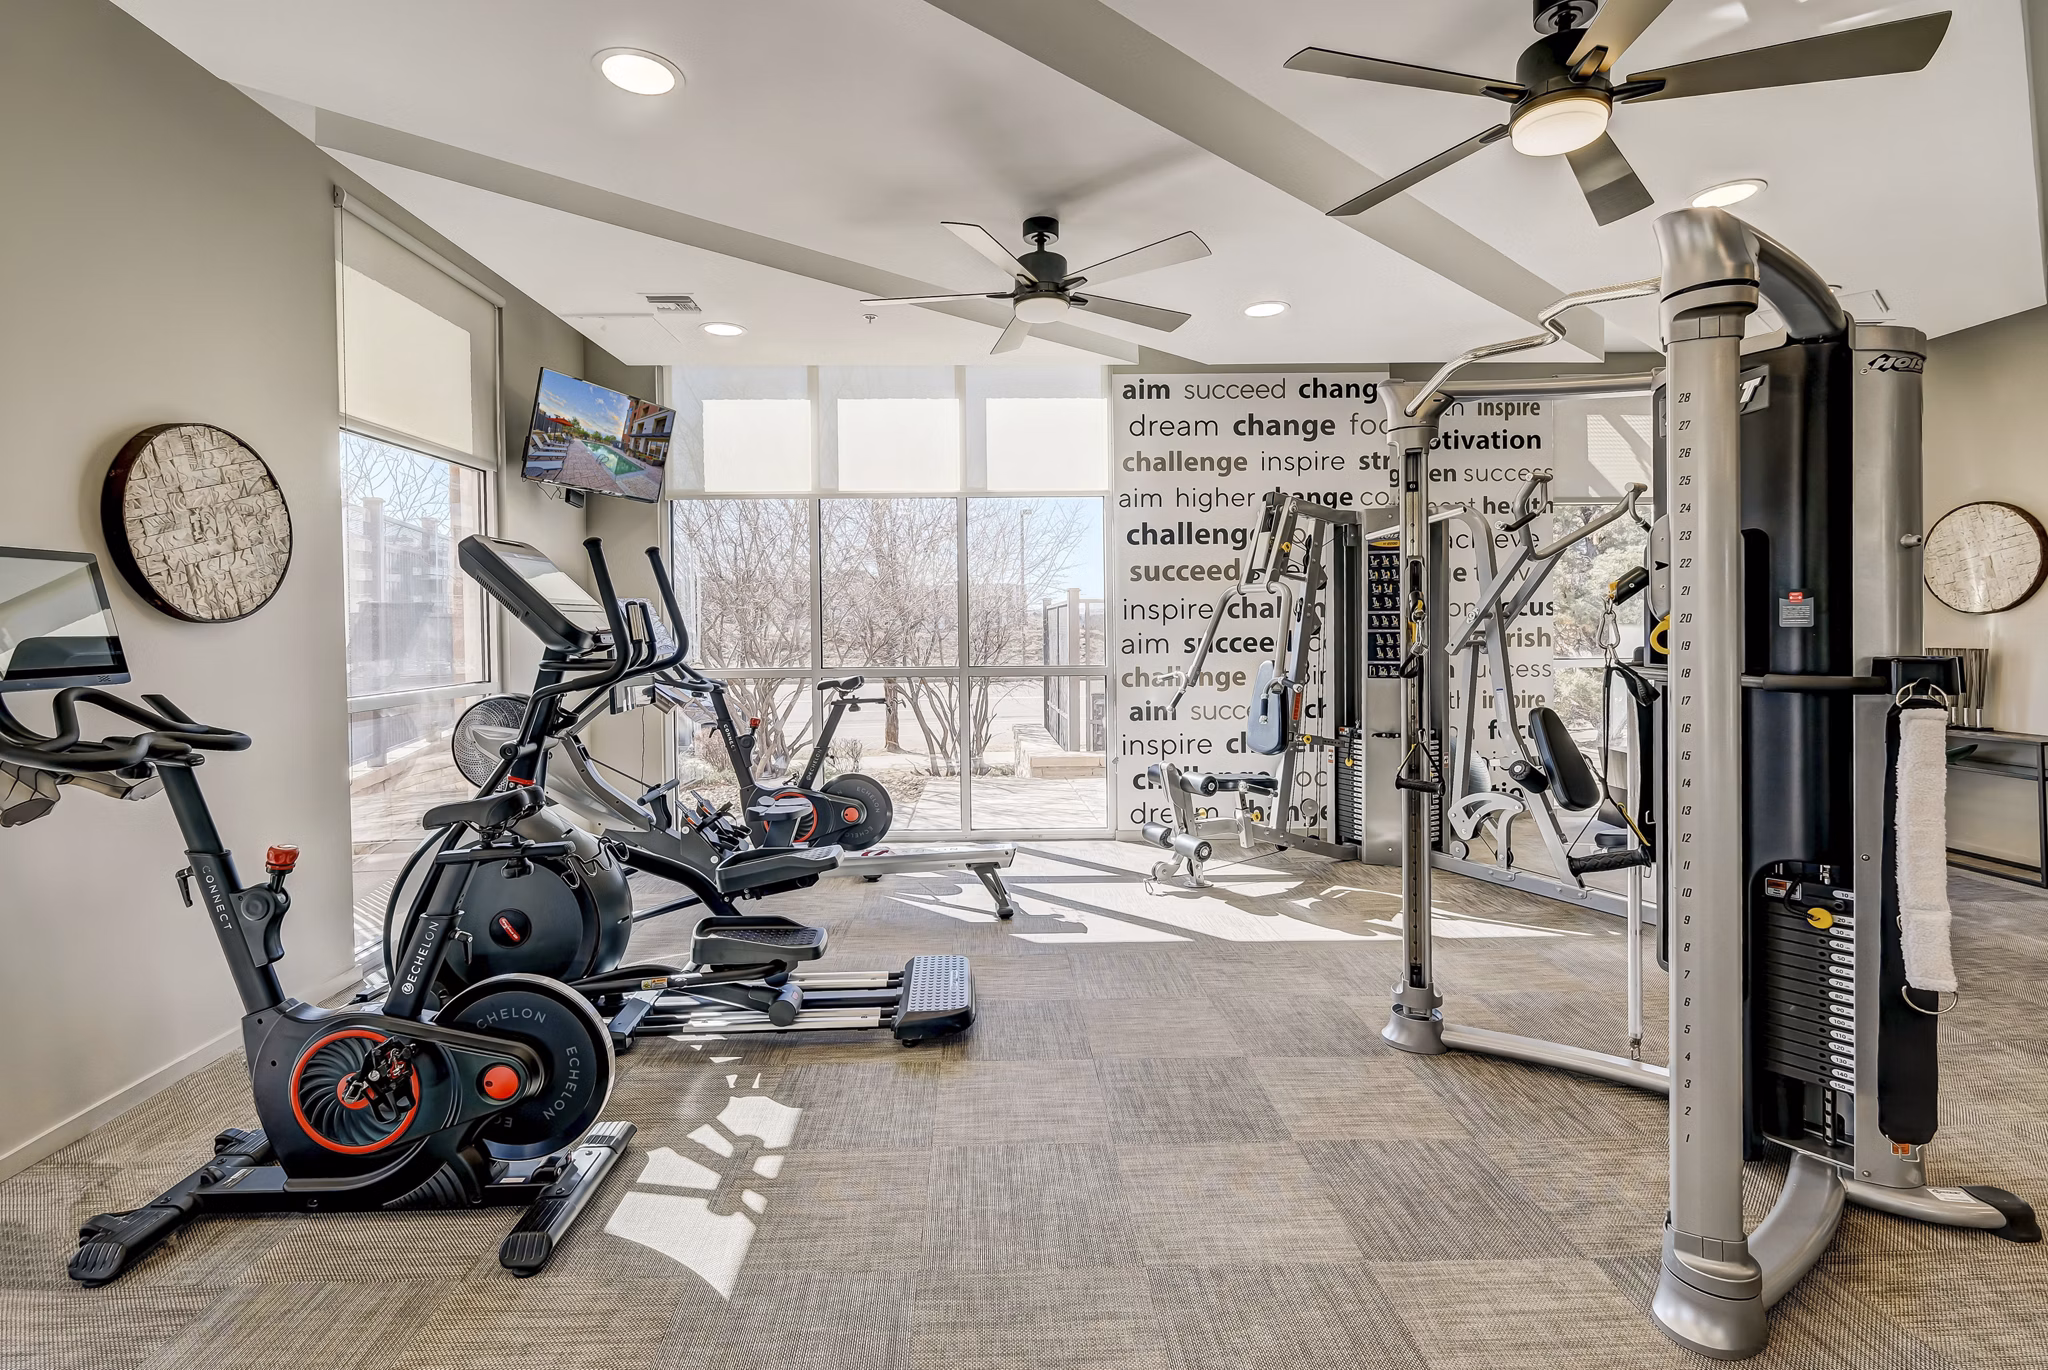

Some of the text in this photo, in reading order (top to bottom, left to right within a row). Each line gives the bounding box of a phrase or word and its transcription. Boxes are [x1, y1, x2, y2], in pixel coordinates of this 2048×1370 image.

[1869, 355, 1925, 371] HOIS
[1122, 378, 1170, 400] aim
[1184, 378, 1286, 400] succeed
[1298, 377, 1378, 404] chang
[1477, 402, 1541, 421] inspire
[1678, 392, 1691, 404] 28
[1678, 420, 1691, 431] 27
[1129, 414, 1219, 436] dream
[1233, 413, 1336, 442] change
[1429, 429, 1542, 450] otivation
[1678, 448, 1691, 458] 26
[1122, 451, 1248, 477] challenge
[1261, 451, 1345, 477] inspire
[1679, 475, 1691, 486] 25
[1118, 488, 1163, 508] aim
[1176, 487, 1256, 513] higher
[1483, 496, 1554, 514] helth
[1679, 503, 1691, 513] 24
[1126, 521, 1255, 550] challeng
[1679, 530, 1692, 541] 23
[1679, 558, 1692, 569] 22
[1130, 558, 1241, 582] succeed
[1681, 585, 1691, 596] 21
[1123, 598, 1214, 626] inspire
[1679, 613, 1692, 623] 20
[1121, 633, 1169, 654] aim
[1681, 640, 1691, 651] 19
[1681, 668, 1691, 678] 18
[1121, 666, 1247, 692] challnge
[1681, 695, 1691, 706] 17
[1129, 700, 1177, 721] aim
[1681, 723, 1691, 733] 16
[1122, 734, 1213, 759] inspire
[1681, 751, 1691, 761] 15
[1681, 778, 1691, 788] 14
[856, 786, 880, 813] ECHELON
[1131, 802, 1219, 824] drem
[1681, 805, 1692, 815] 13
[845, 826, 873, 838] ECHELO
[1681, 833, 1692, 843] 12
[1683, 860, 1691, 870] 11
[202, 865, 233, 930] CONNECT
[1681, 887, 1692, 898] 10
[1684, 915, 1691, 925] 9
[407, 921, 440, 983] ECHELON
[1684, 942, 1691, 952] 8
[1684, 970, 1691, 979] 7
[1684, 997, 1691, 1007] 6
[476, 1008, 547, 1029] CHELON
[1684, 1024, 1691, 1034] 5
[1684, 1052, 1691, 1061] 4
[543, 1046, 580, 1120] ECHELON
[1684, 1079, 1692, 1088] 3
[1834, 1082, 1846, 1090] 150
[1684, 1106, 1692, 1116] 2
